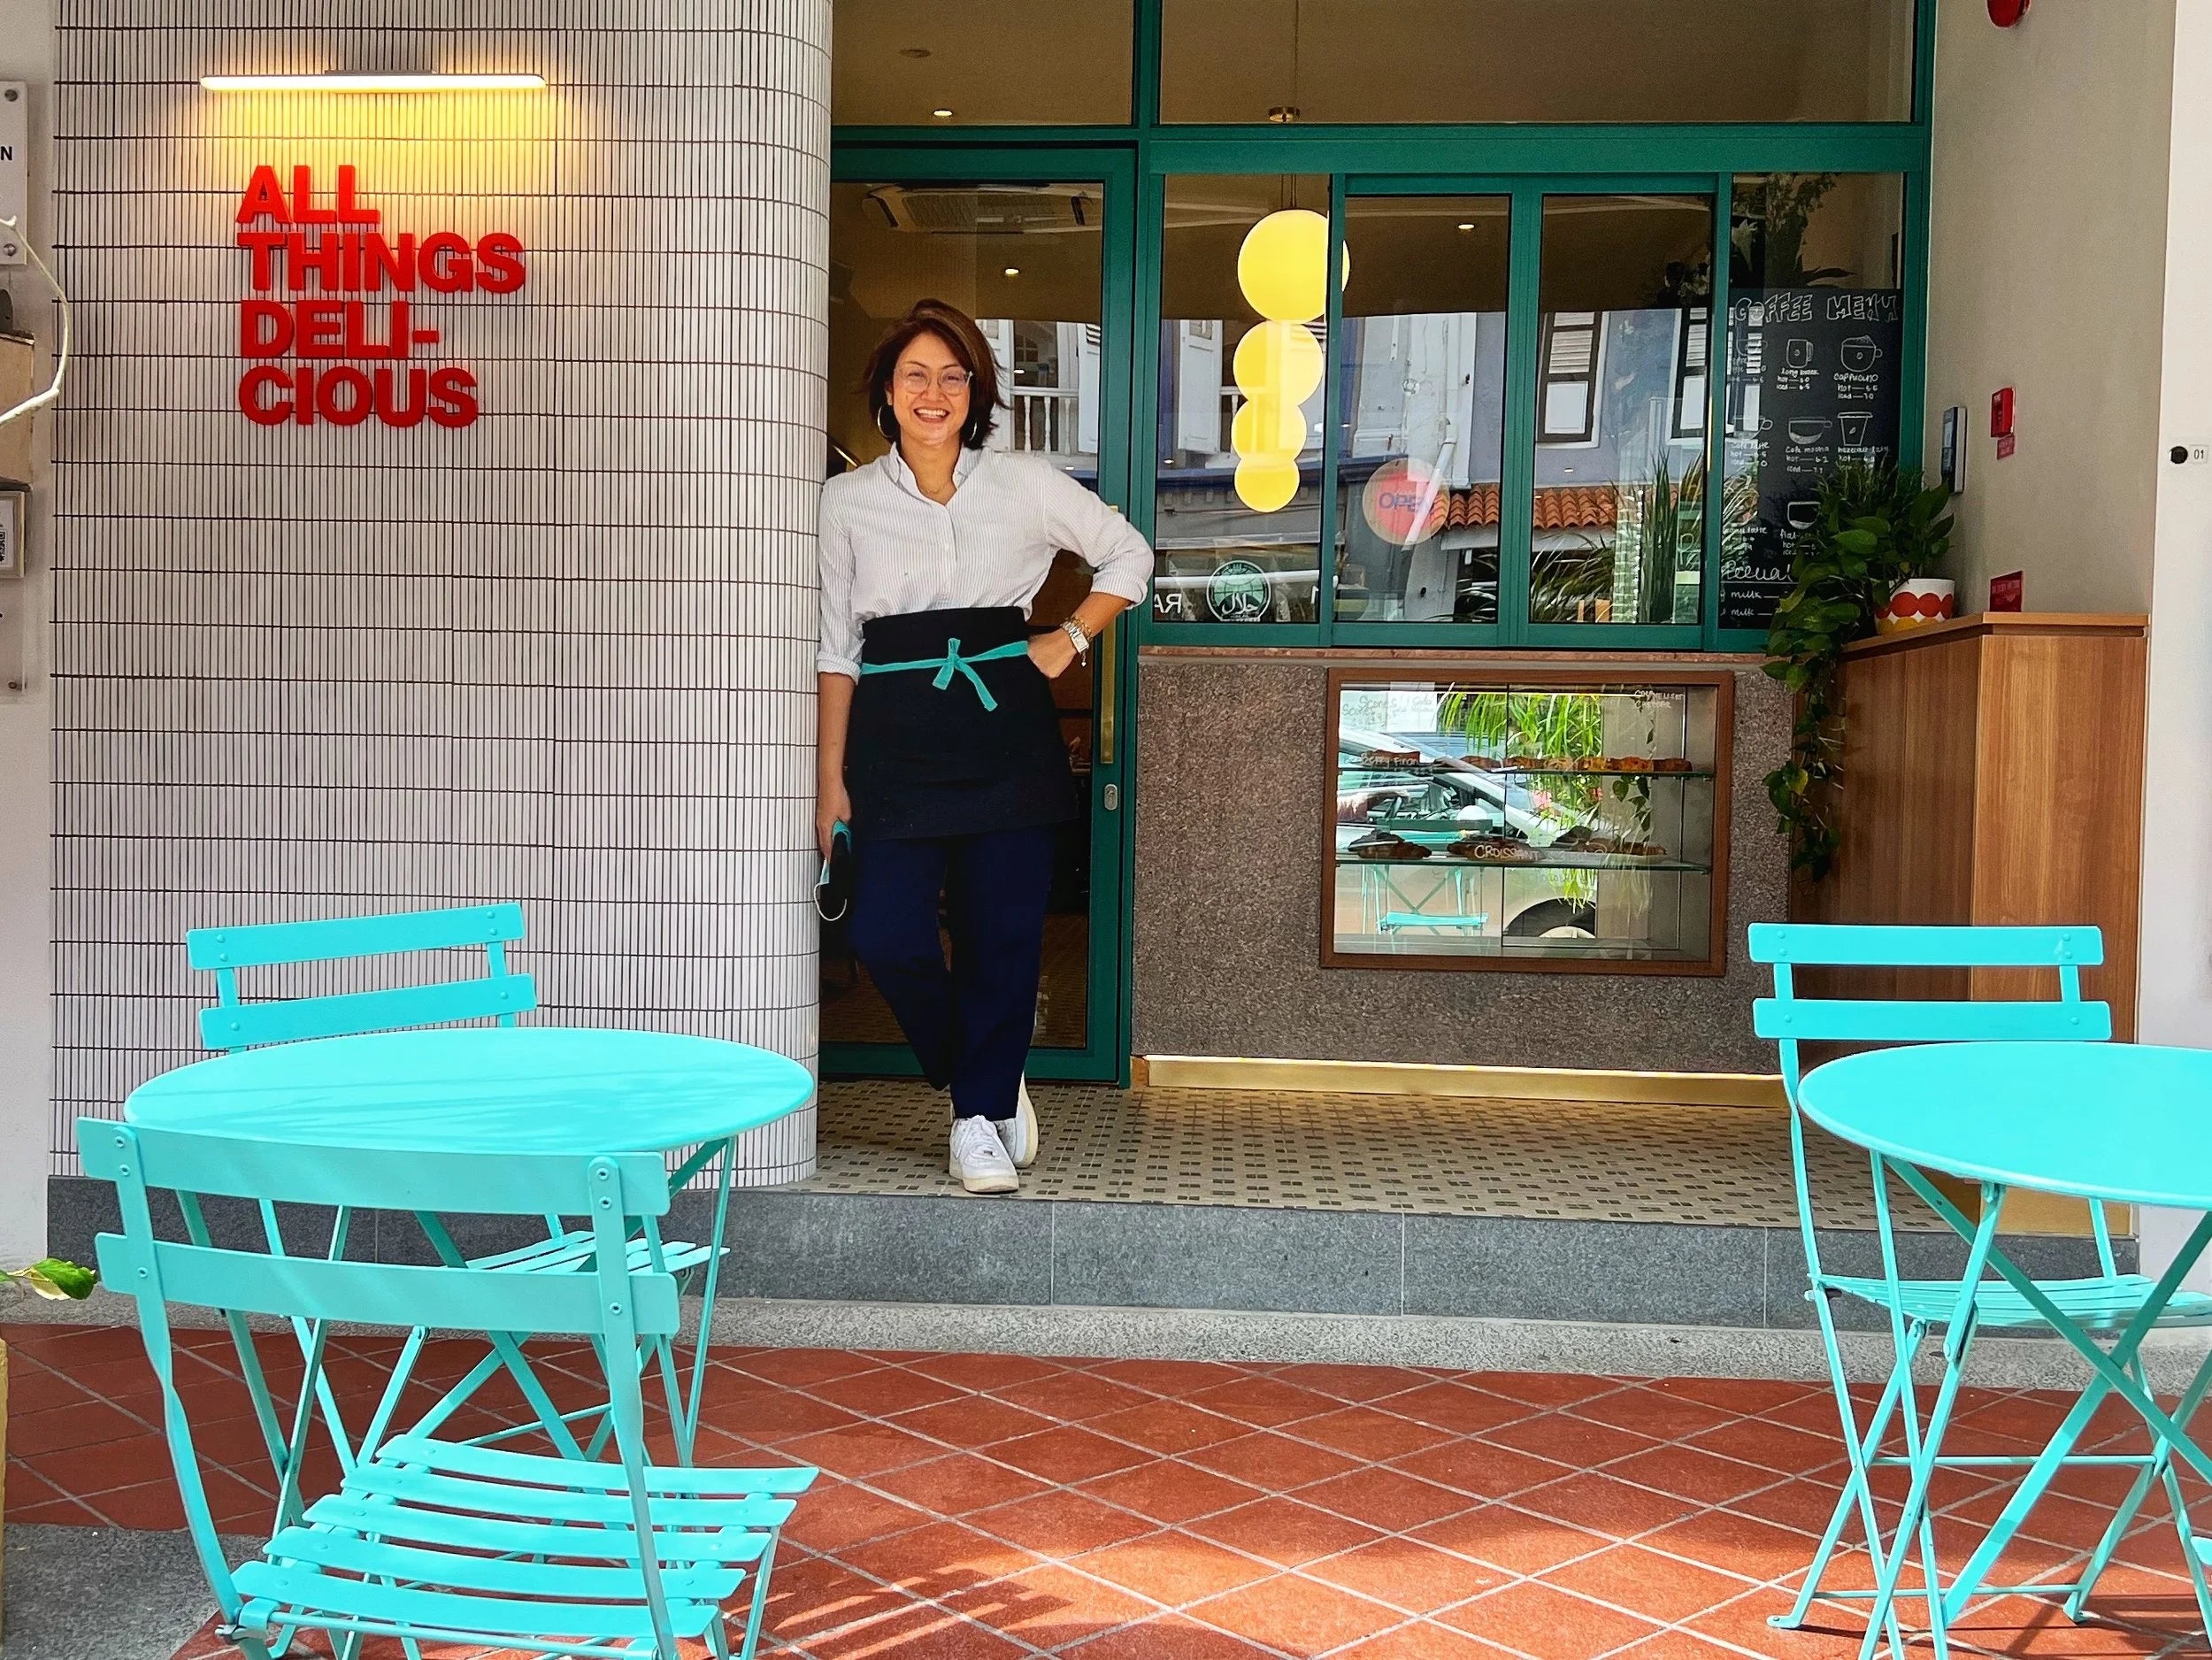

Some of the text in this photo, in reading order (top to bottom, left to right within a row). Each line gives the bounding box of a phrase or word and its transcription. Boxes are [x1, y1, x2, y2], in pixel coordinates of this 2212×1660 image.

[235, 165, 381, 225] ALL
[236, 232, 526, 294] THINGS
[240, 299, 440, 360] DELI-
[1826, 293, 1899, 323] MENU
[238, 365, 480, 428] CIOUS
[2193, 449, 2204, 460] 01
[1379, 492, 1434, 513] OPE
[1473, 844, 1540, 862] CROISSANT
